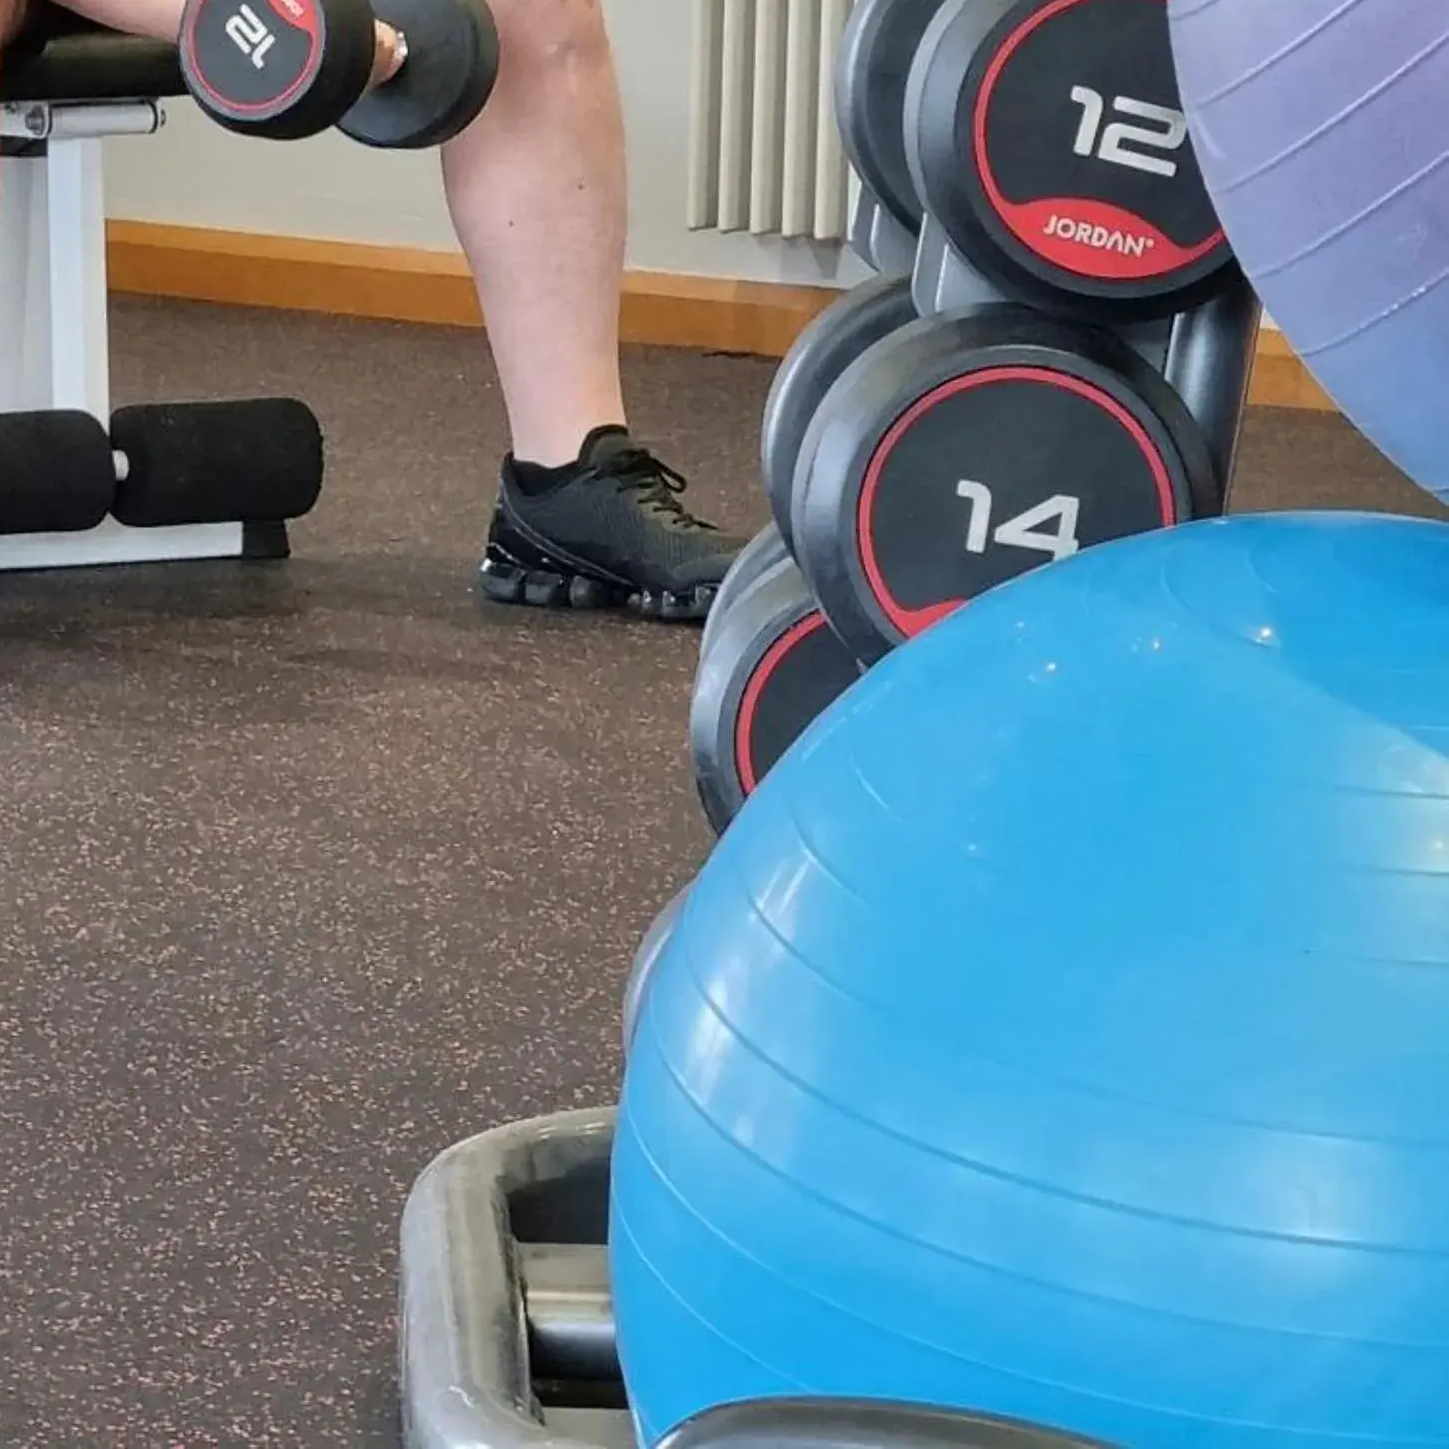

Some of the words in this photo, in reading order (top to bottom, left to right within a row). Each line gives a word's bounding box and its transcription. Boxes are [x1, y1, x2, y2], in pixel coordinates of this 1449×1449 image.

[225, 3, 275, 69] 12
[1071, 85, 1188, 177] 12
[1043, 214, 1146, 257] JORDAN
[956, 479, 1080, 561] 14
